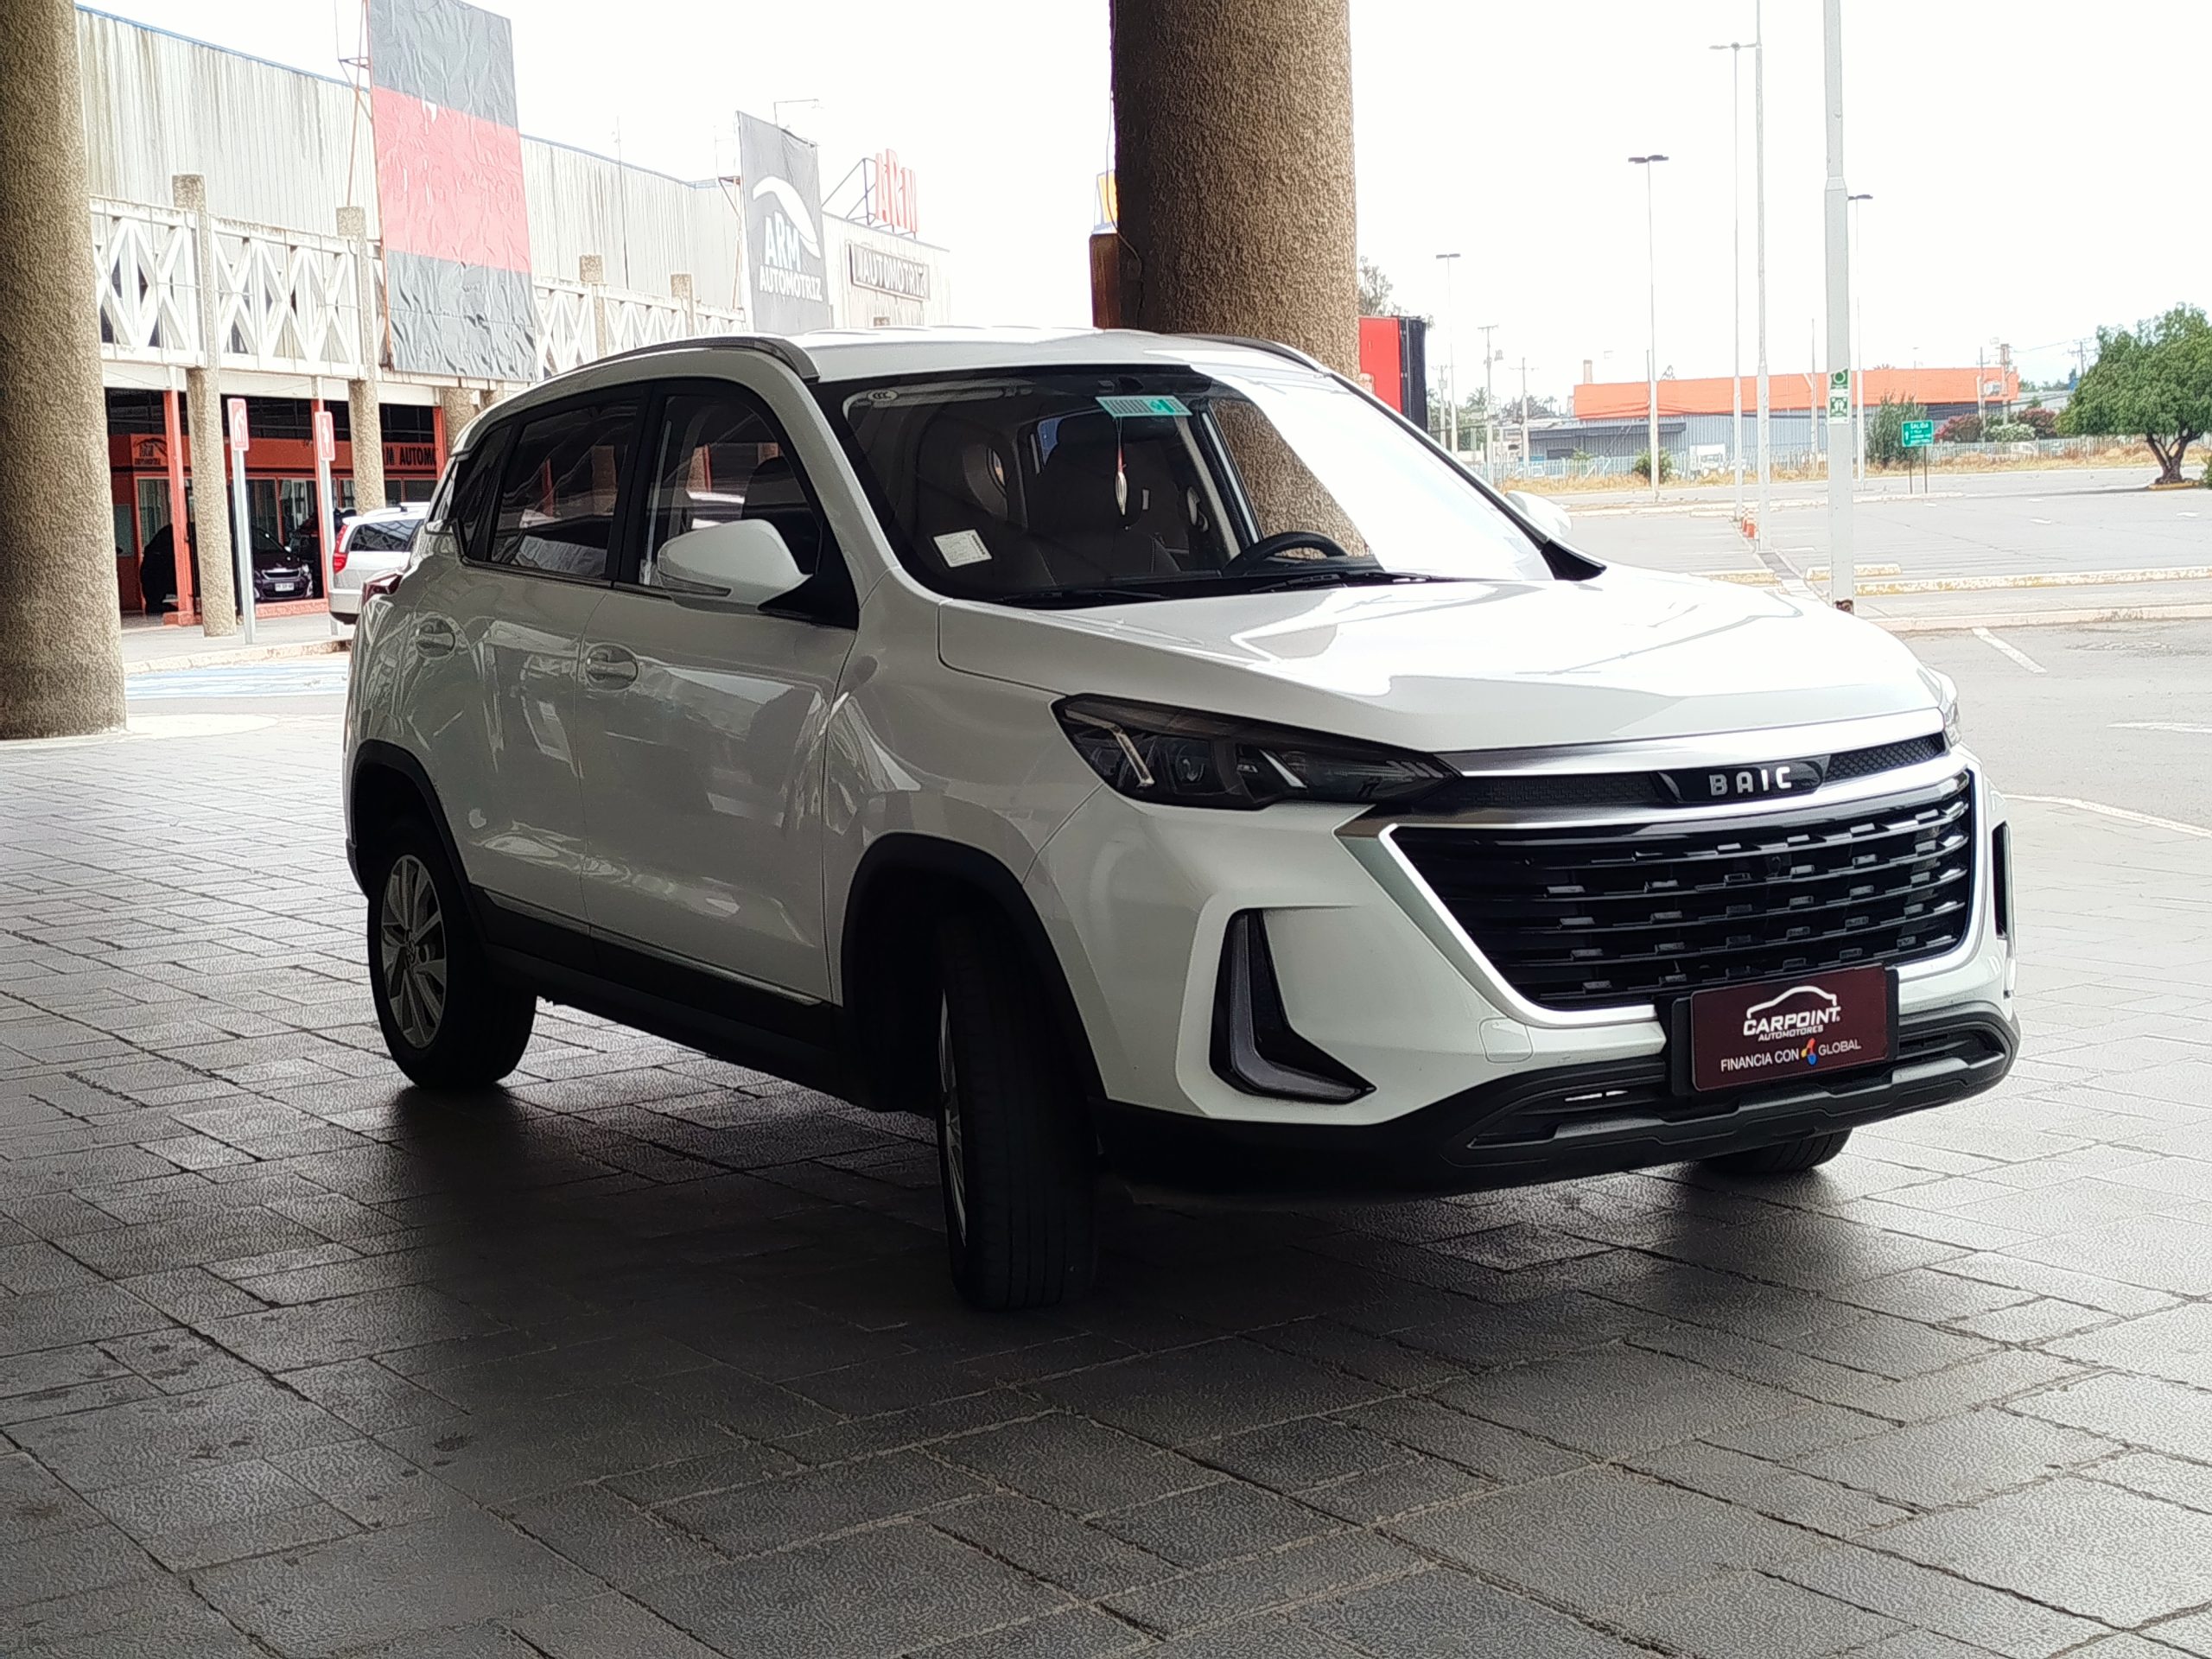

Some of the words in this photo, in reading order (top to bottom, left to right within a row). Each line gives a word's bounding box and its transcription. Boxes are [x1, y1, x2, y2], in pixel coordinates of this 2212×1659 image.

[764, 210, 802, 273] ARM
[760, 264, 823, 302] AUTOMOTRIZ
[1709, 766, 1792, 796] BAIC
[1758, 1025, 1823, 1041] AUTOMOTORES
[1721, 1053, 1772, 1072] FINANCIA
[1774, 1048, 1800, 1064] CON
[1818, 1039, 1861, 1056] GLOBAL
